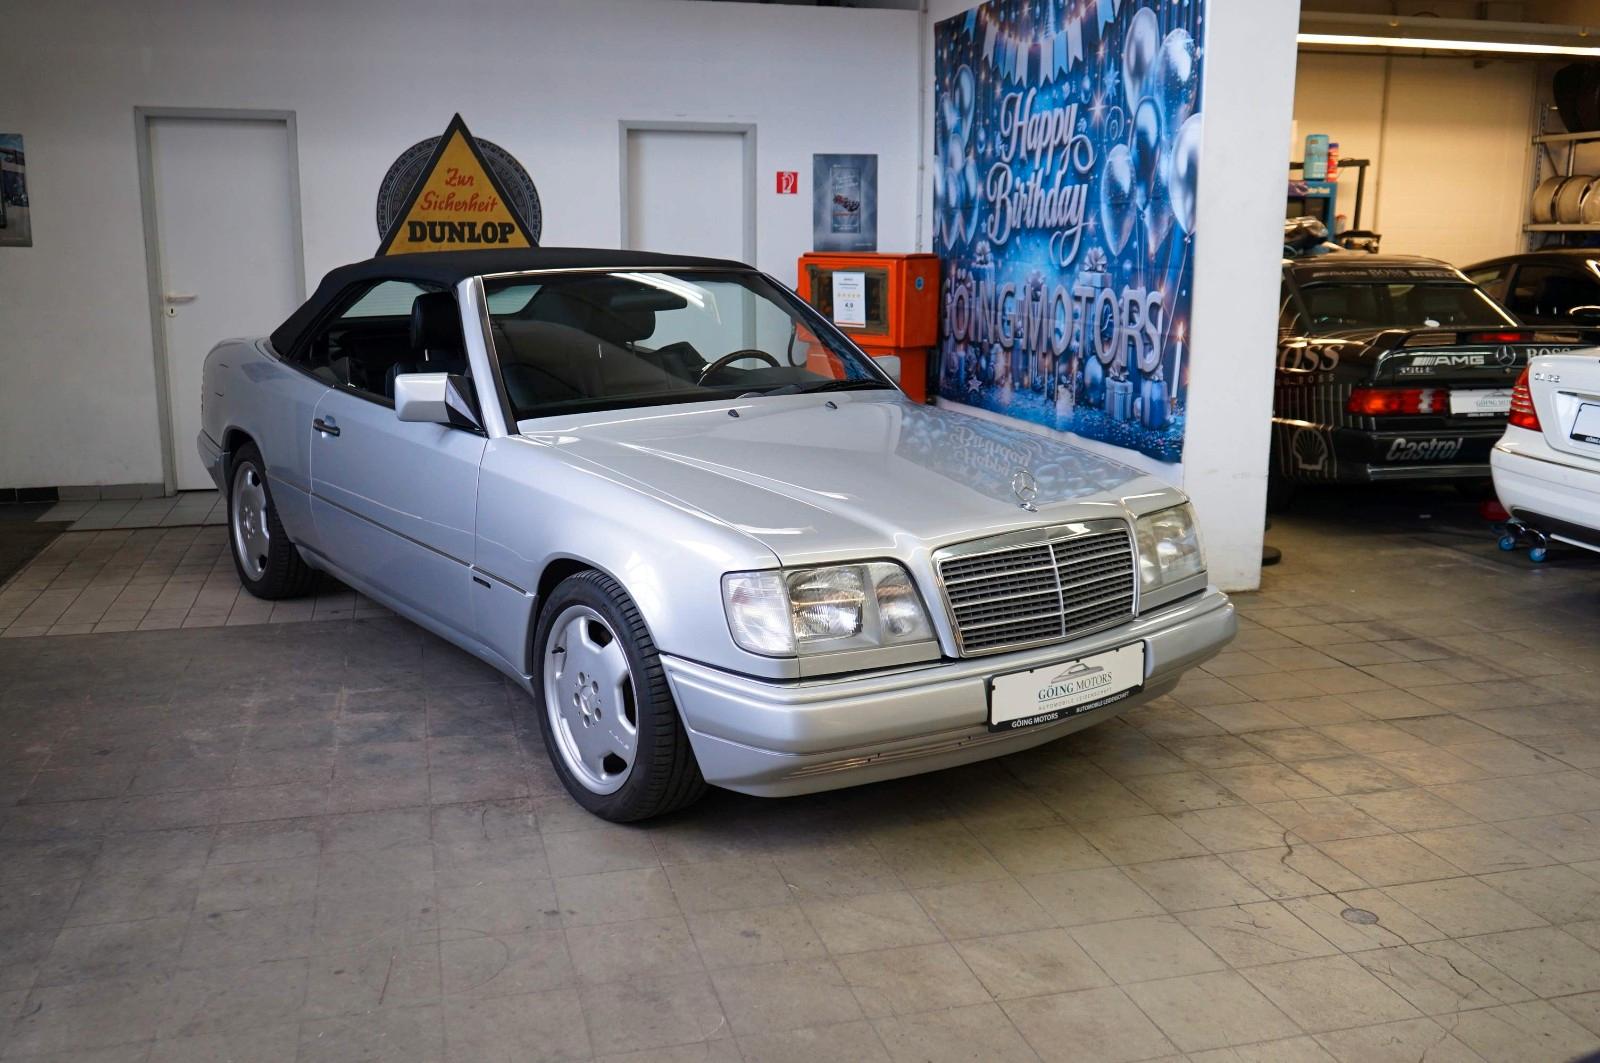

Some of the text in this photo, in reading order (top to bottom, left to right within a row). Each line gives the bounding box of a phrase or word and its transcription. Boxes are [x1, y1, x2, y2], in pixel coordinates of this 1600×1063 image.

[1001, 87, 1096, 175] Happy
[445, 167, 475, 187] Zur
[420, 191, 498, 213] Sicherheit
[987, 162, 1088, 267] Birthday
[408, 220, 515, 243] DUNLOP
[1021, 284, 1164, 373] MOTORS
[1279, 344, 1344, 373] OSS
[1433, 355, 1485, 366] AMG
[1386, 437, 1463, 462] Castrol
[1038, 672, 1112, 700] GÖING MOTORS
[1011, 717, 1033, 728] GÖING
[1033, 712, 1059, 724] MOTORS
